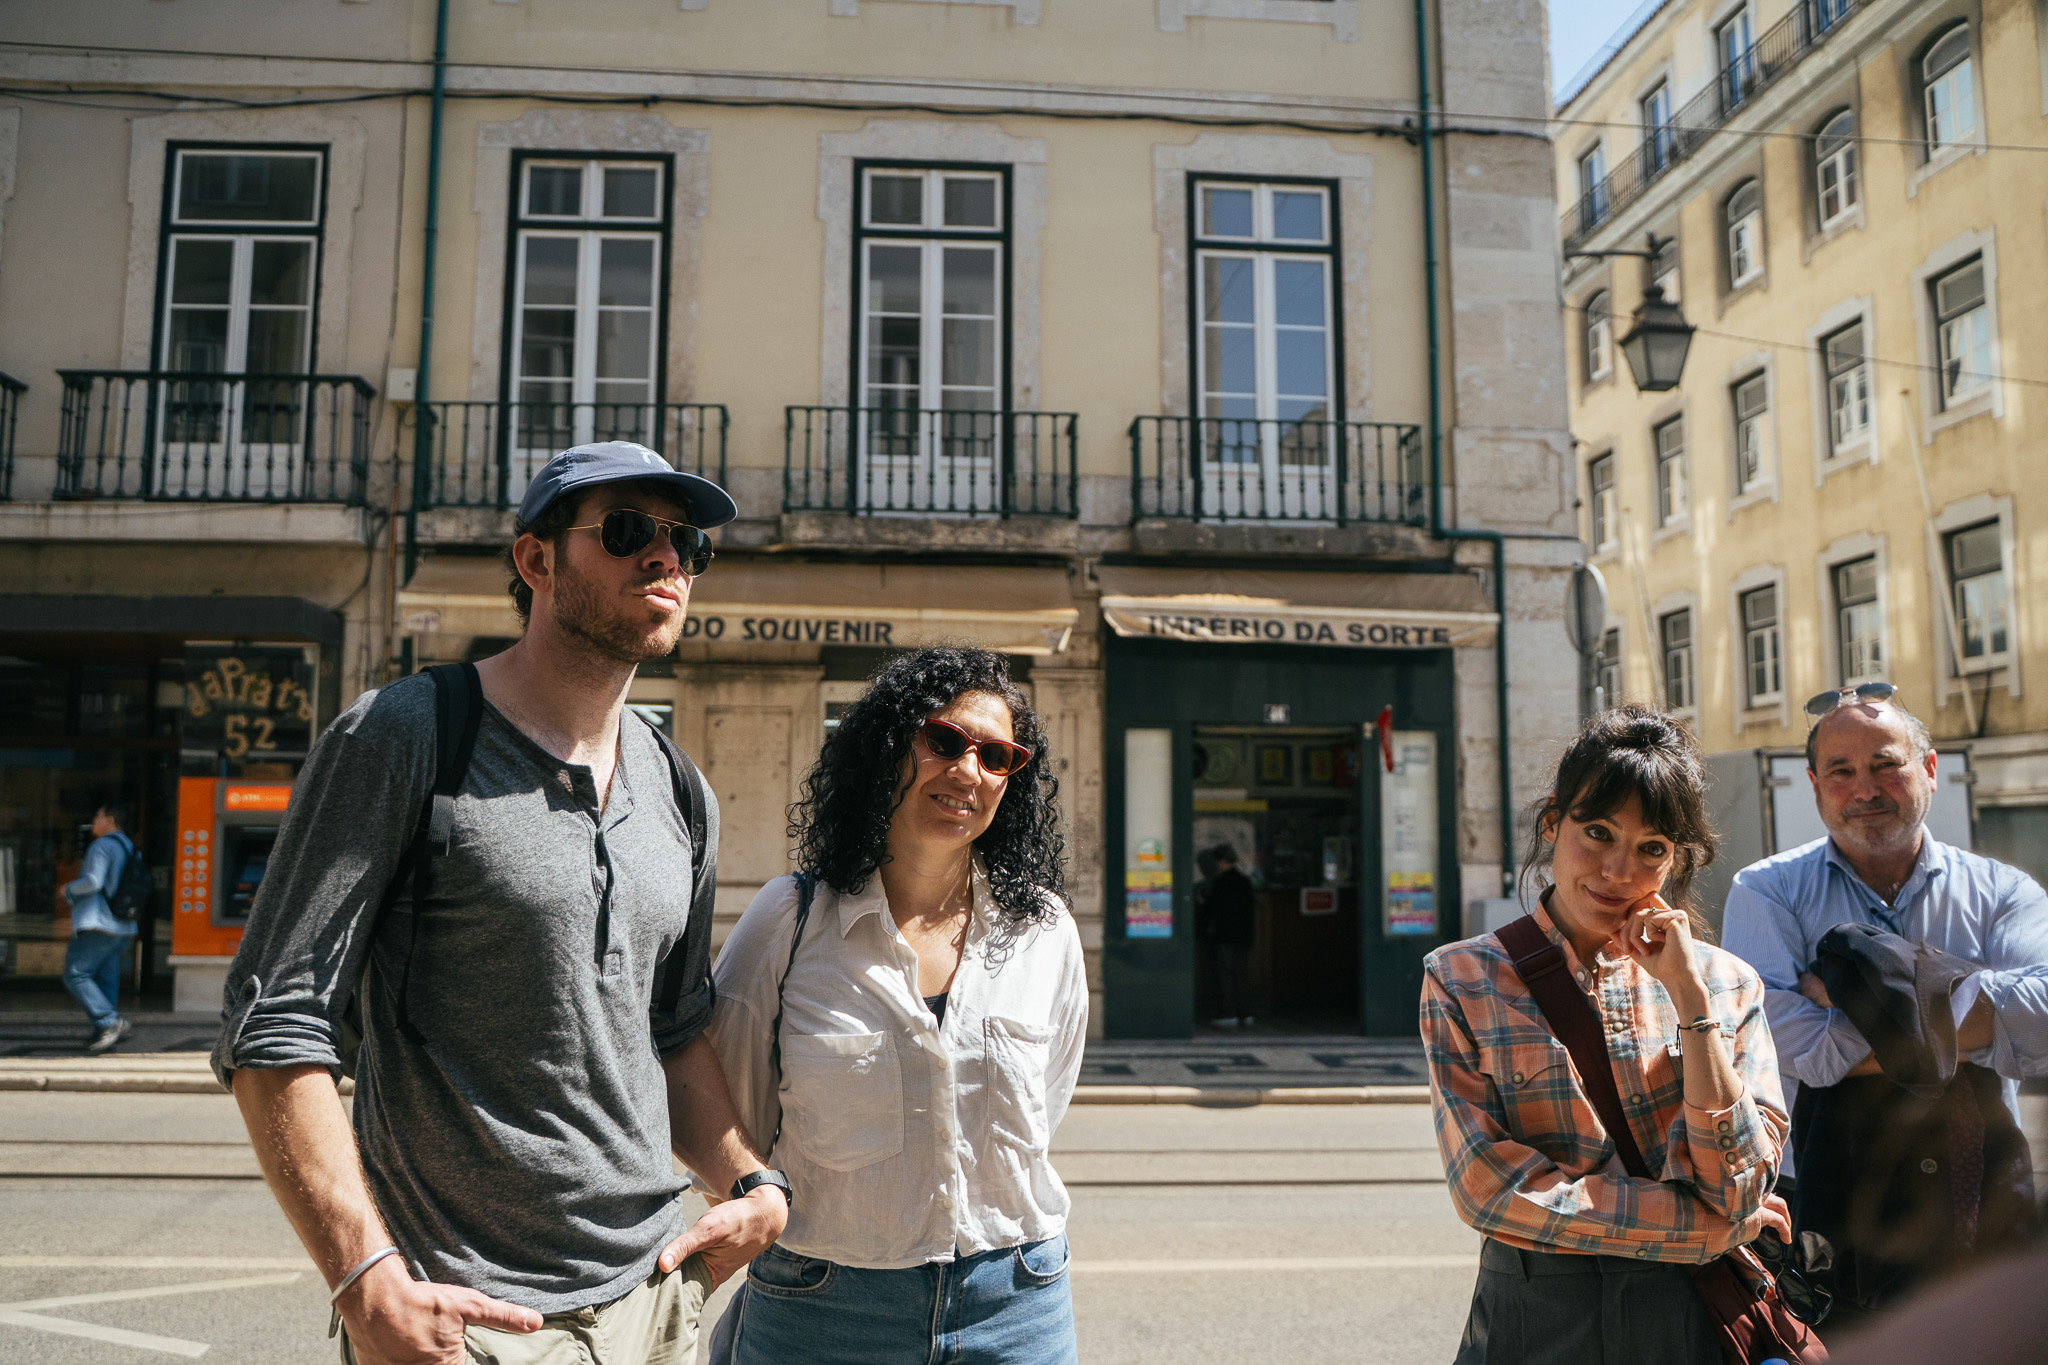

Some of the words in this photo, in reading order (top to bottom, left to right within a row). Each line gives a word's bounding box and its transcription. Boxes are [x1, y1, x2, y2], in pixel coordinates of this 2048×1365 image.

[742, 618, 894, 645] SOUVENIR
[1295, 621, 1336, 642] DA
[1347, 623, 1450, 645] SORTE
[225, 714, 277, 758] 52
